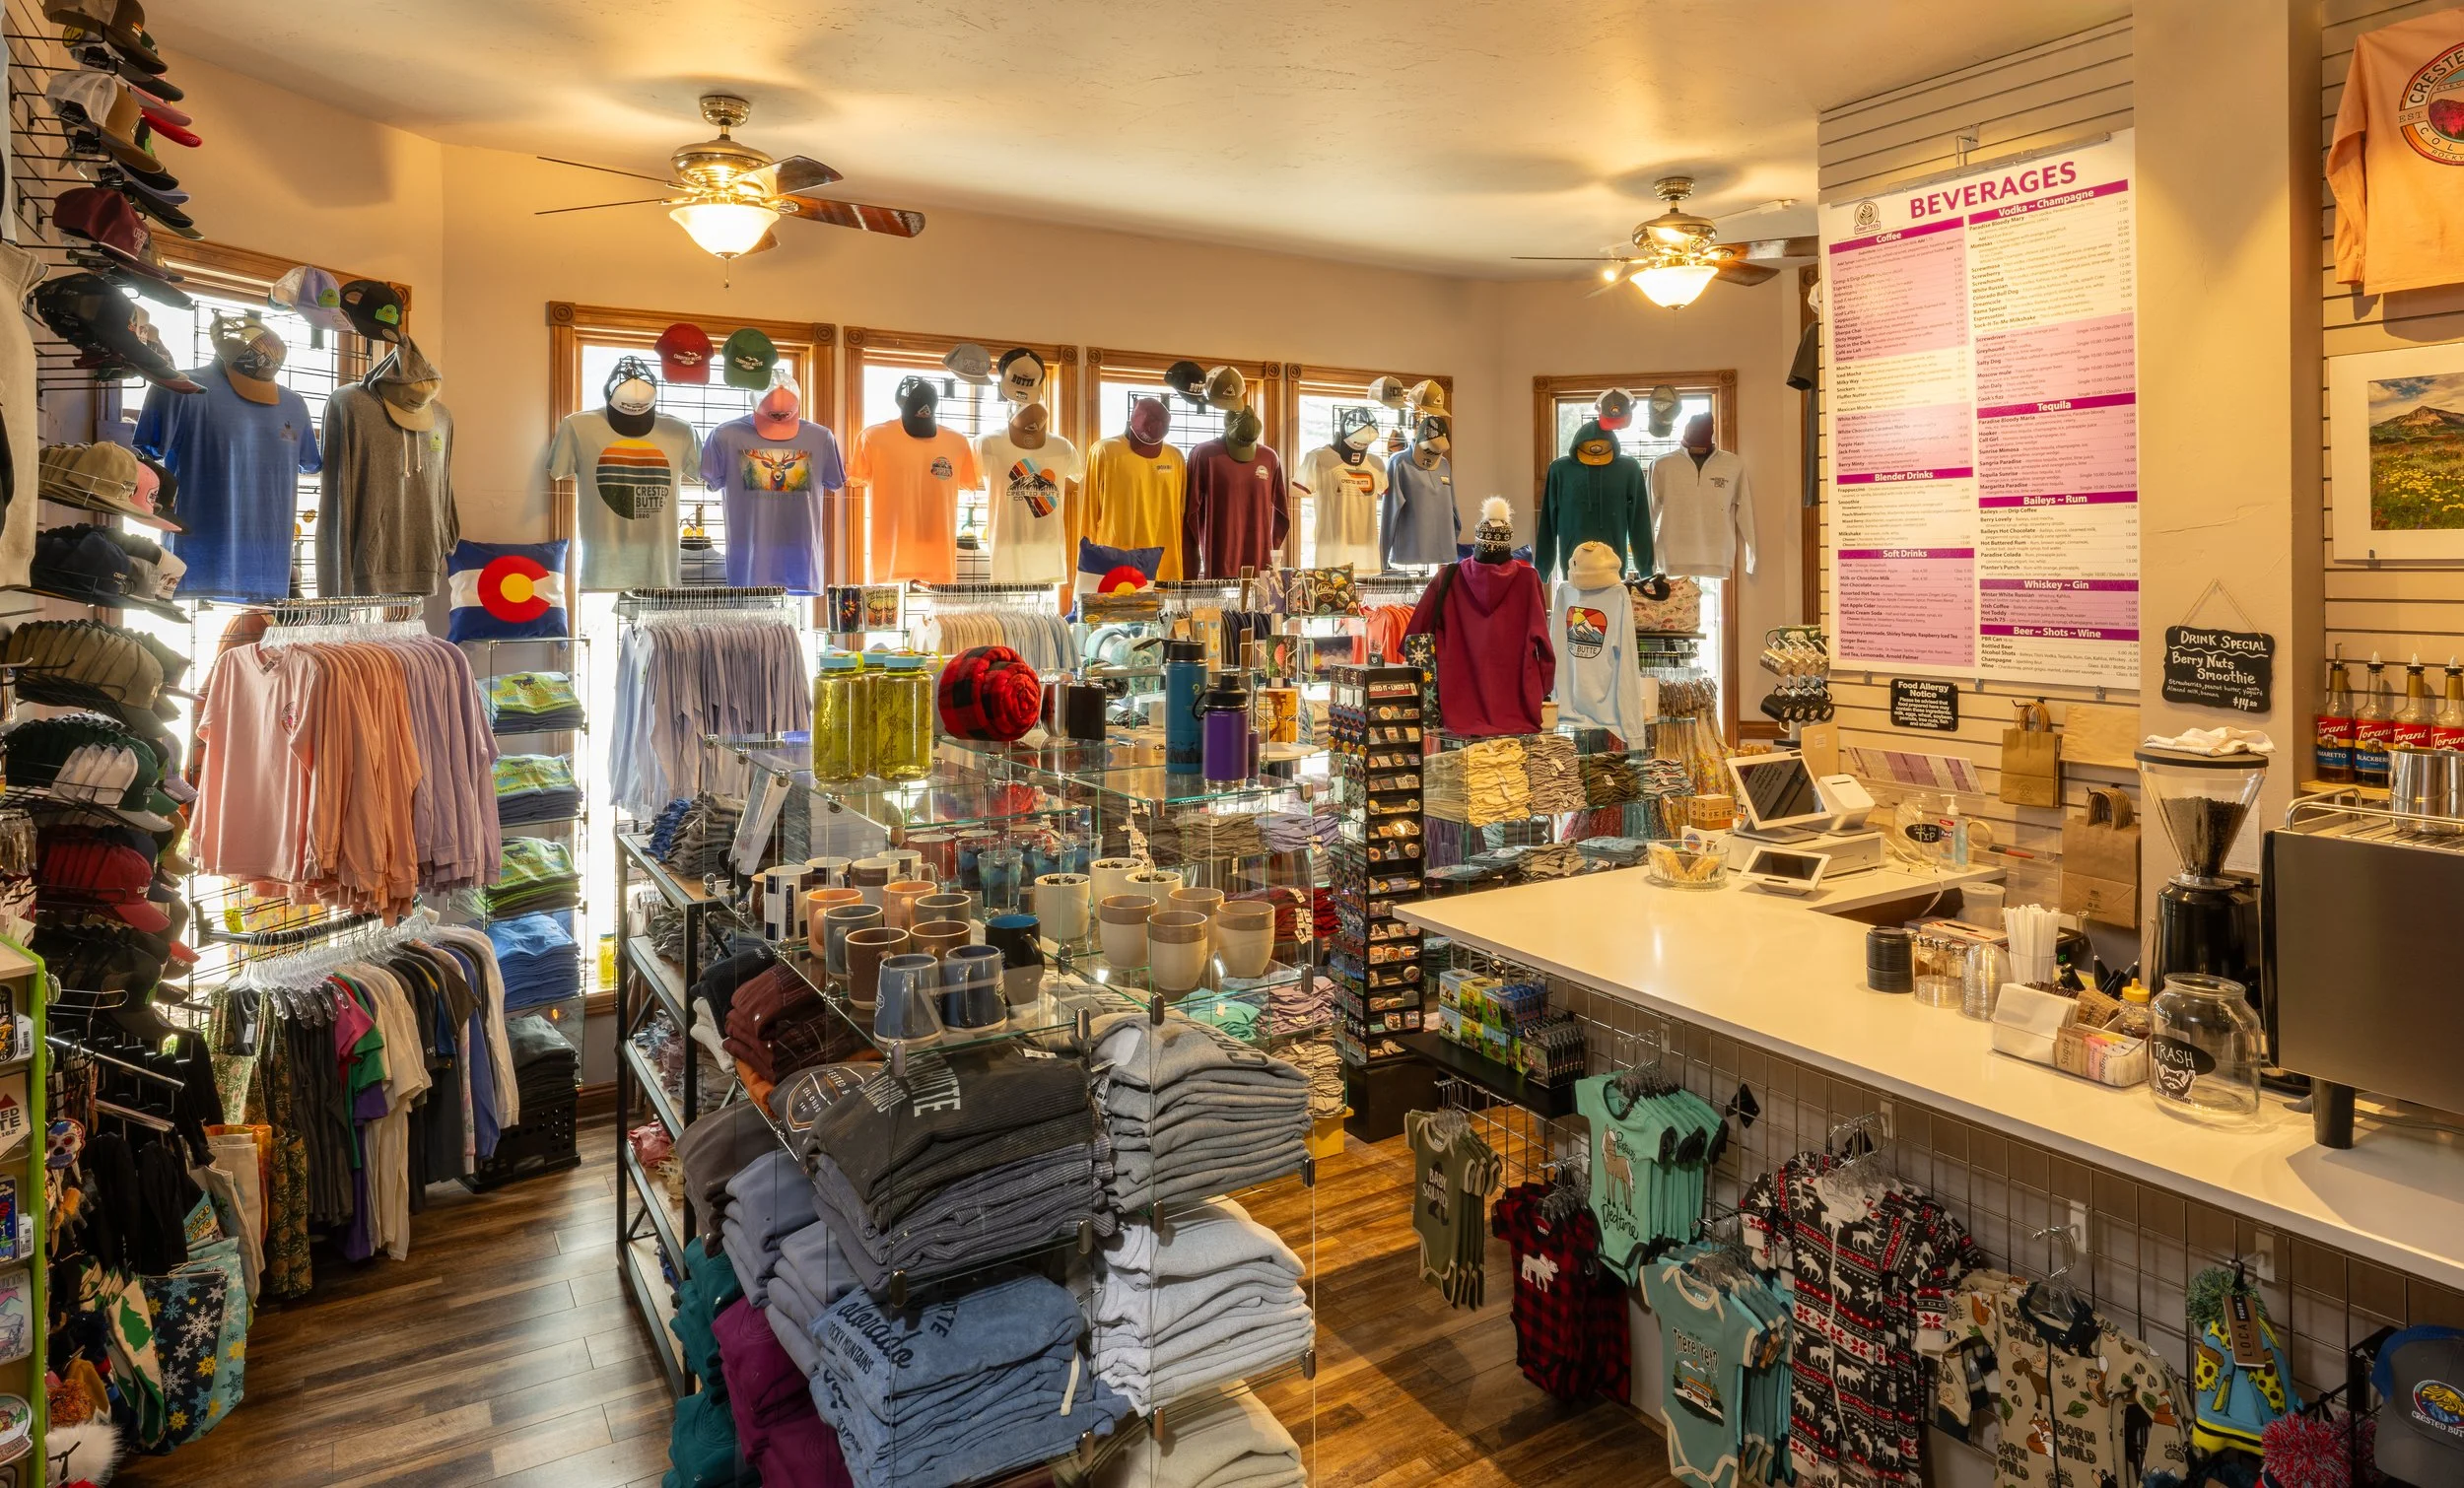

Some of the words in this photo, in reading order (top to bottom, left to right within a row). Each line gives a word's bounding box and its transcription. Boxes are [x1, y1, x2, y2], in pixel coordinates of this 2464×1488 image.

[2409, 50, 2464, 103] CRESTE
[1910, 162, 2077, 219] BEVERAGES
[1999, 204, 2027, 217] Vodka
[2037, 189, 2094, 209] Champagne
[1877, 233, 1901, 243] Coffee
[2037, 401, 2071, 412] Tequila
[1875, 473, 1905, 482] Blender
[1906, 470, 1933, 480] Drinks
[636, 487, 668, 498] CRESTED
[2023, 496, 2056, 507] Baileys
[2065, 495, 2088, 504] Rum
[636, 497, 663, 507] BUTTE
[1901, 549, 1927, 558] Drinks
[2024, 580, 2062, 591] Whiskey
[2073, 580, 2088, 590] Gin
[2014, 627, 2034, 636] Beer
[2043, 628, 2069, 638] Shots
[2180, 631, 2217, 646] DRINK
[2221, 636, 2267, 651] SPECIAL
[1577, 645, 1597, 654] BUTTE
[2172, 651, 2204, 668] Berry
[2207, 654, 2234, 670] Nuts
[2197, 668, 2256, 685] Smoothie
[1919, 682, 1950, 693] Allergy
[2317, 721, 2349, 736] Torani
[2357, 725, 2392, 741] Torani
[2393, 728, 2427, 745] Torani
[2432, 733, 2464, 750] Toran
[1915, 831, 1936, 842] TIP
[2061, 1038, 2070, 1066] Sugar
[2154, 1042, 2194, 1068] TRASH
[2100, 1052, 2109, 1080] Sugar
[0, 1108, 20, 1118] ED
[1428, 1168, 1447, 1191] BABY
[1601, 1204, 1639, 1241] Bedtime
[837, 1302, 923, 1369] olorado
[1673, 1327, 1696, 1357] There
[2004, 1322, 2043, 1348] WILD
[1698, 1342, 1719, 1378] Yet?
[2056, 1420, 2097, 1446] BORN
[2447, 1426, 2464, 1438] BUT
[2057, 1440, 2097, 1464] WILD
